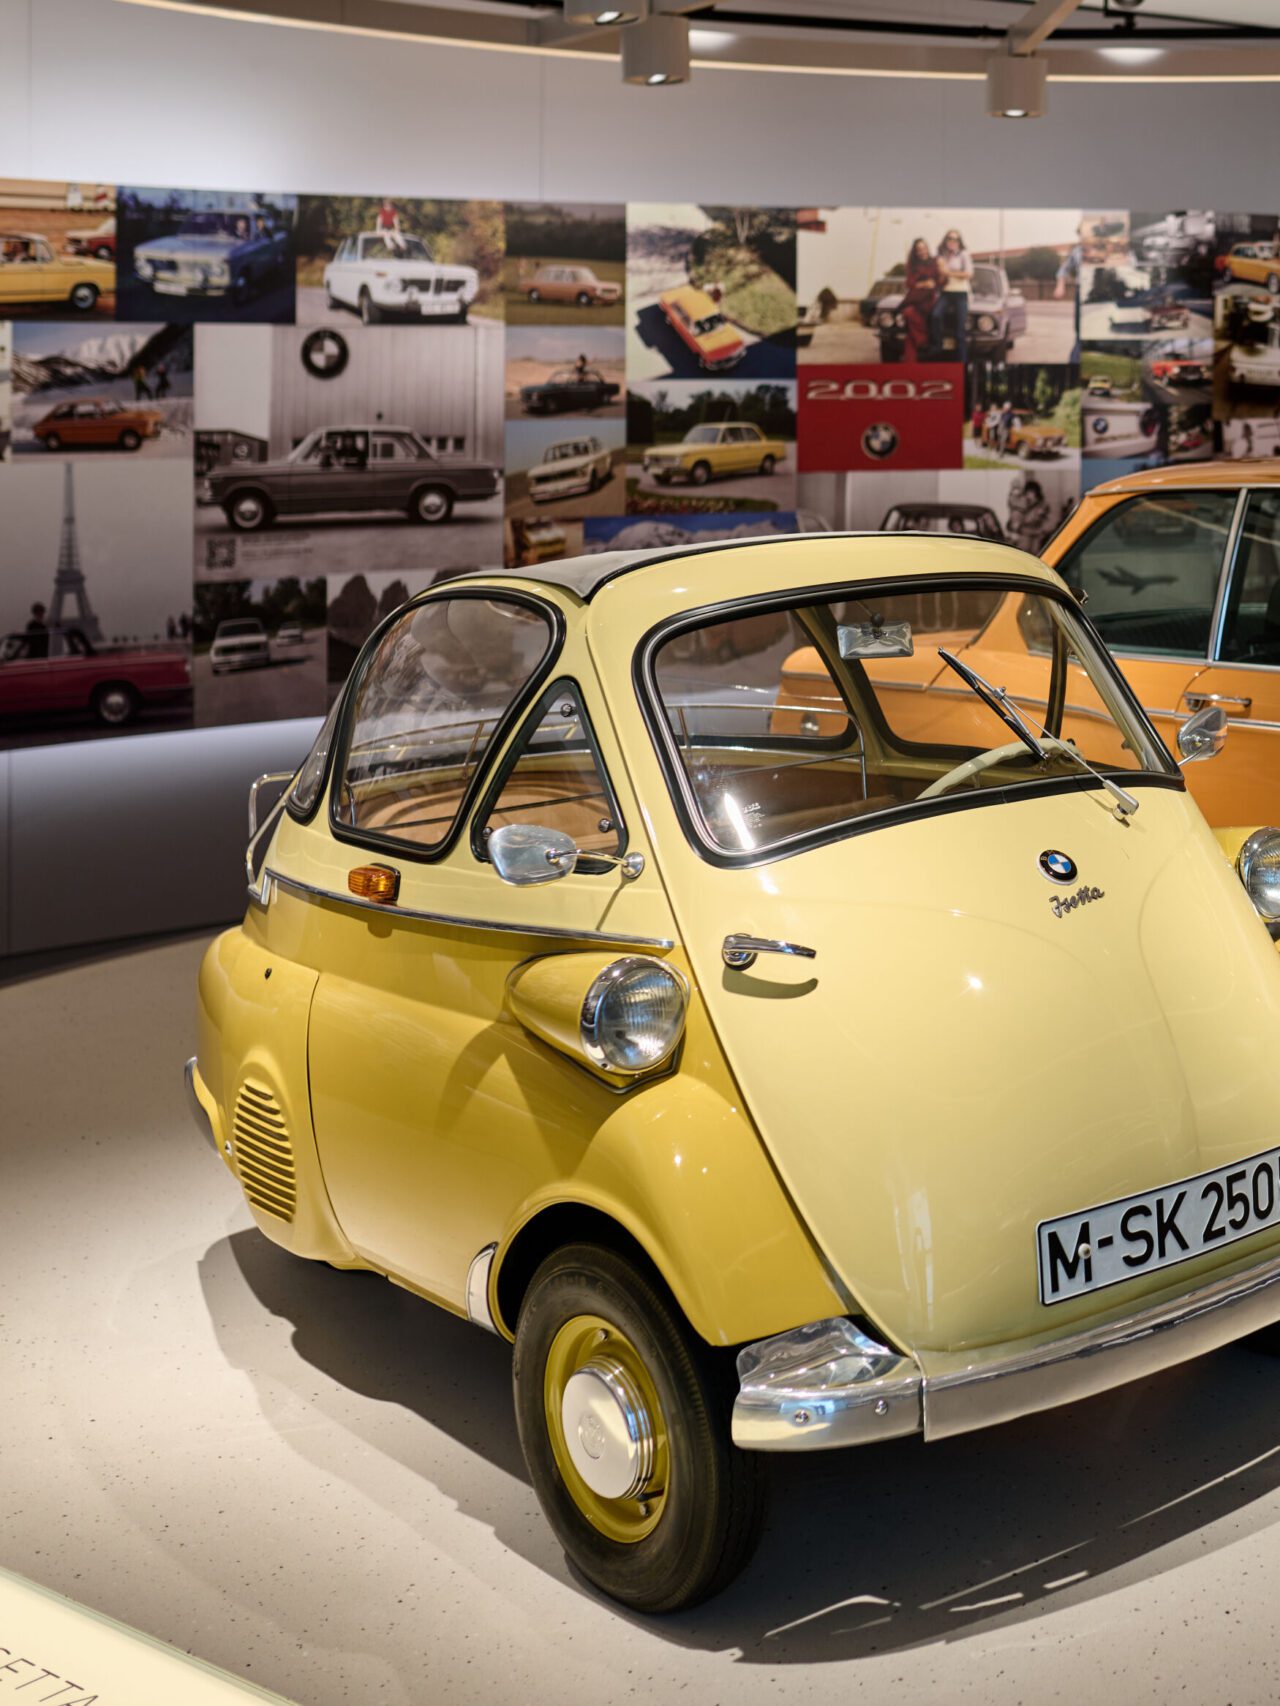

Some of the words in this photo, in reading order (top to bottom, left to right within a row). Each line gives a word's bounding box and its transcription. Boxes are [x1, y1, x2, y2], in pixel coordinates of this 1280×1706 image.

[806, 379, 953, 400] 2002
[1049, 886, 1105, 918] Isetta
[1048, 1191, 1190, 1293] M-SK
[0, 1647, 99, 1706] ETTA
